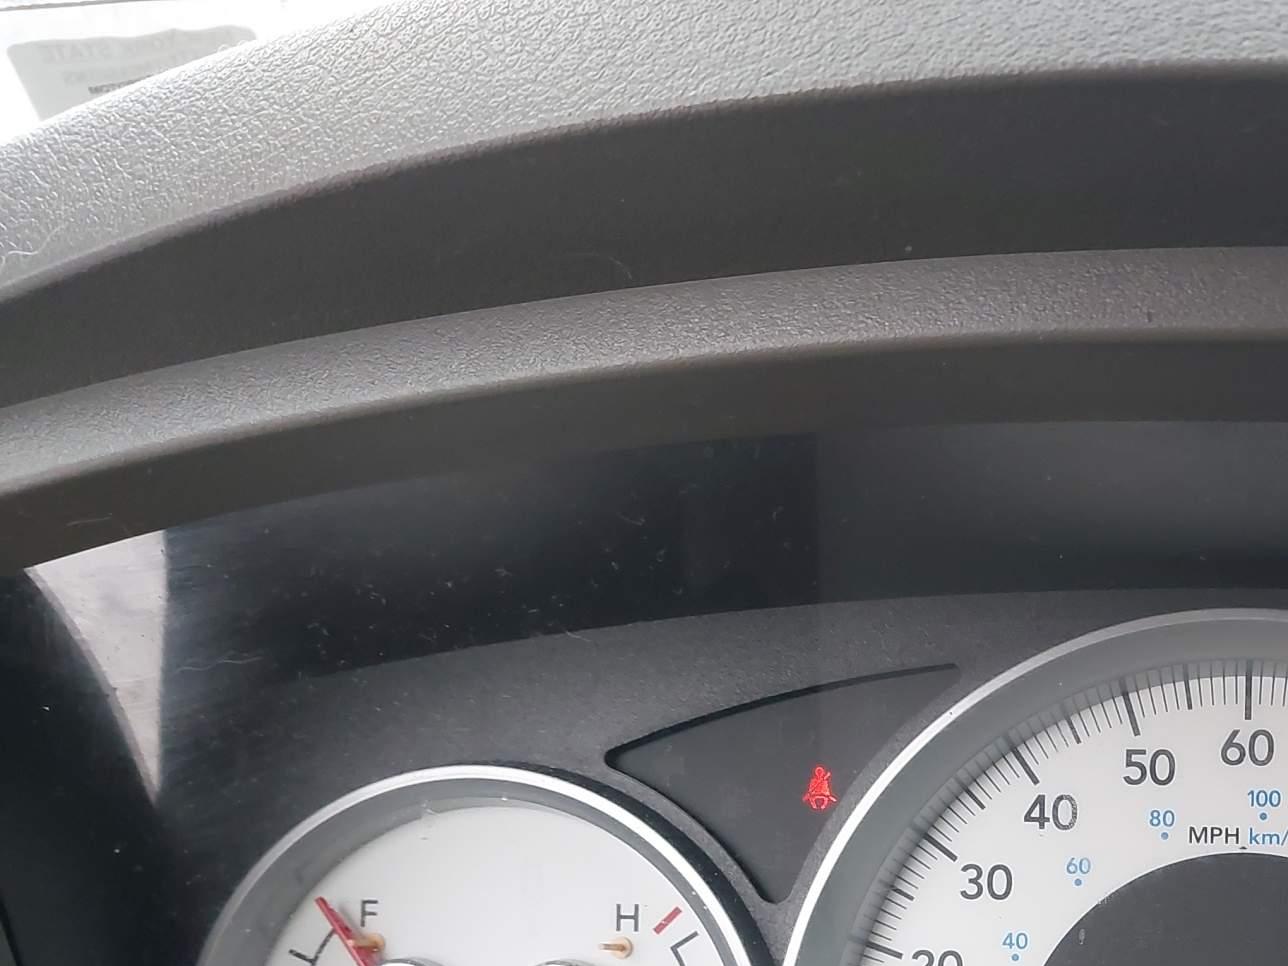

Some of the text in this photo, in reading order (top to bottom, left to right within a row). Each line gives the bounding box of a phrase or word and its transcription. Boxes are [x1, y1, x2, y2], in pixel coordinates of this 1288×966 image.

[1221, 730, 1274, 766] 60
[1123, 749, 1175, 785] 50
[1246, 789, 1282, 808] 100
[1024, 795, 1077, 830] 40
[1147, 810, 1177, 829] 80
[1189, 827, 1239, 844] MPH
[1065, 860, 1090, 876] 60
[961, 864, 1012, 900] 30
[361, 900, 378, 927] F
[616, 904, 639, 932] H
[1001, 931, 1029, 951] 40
